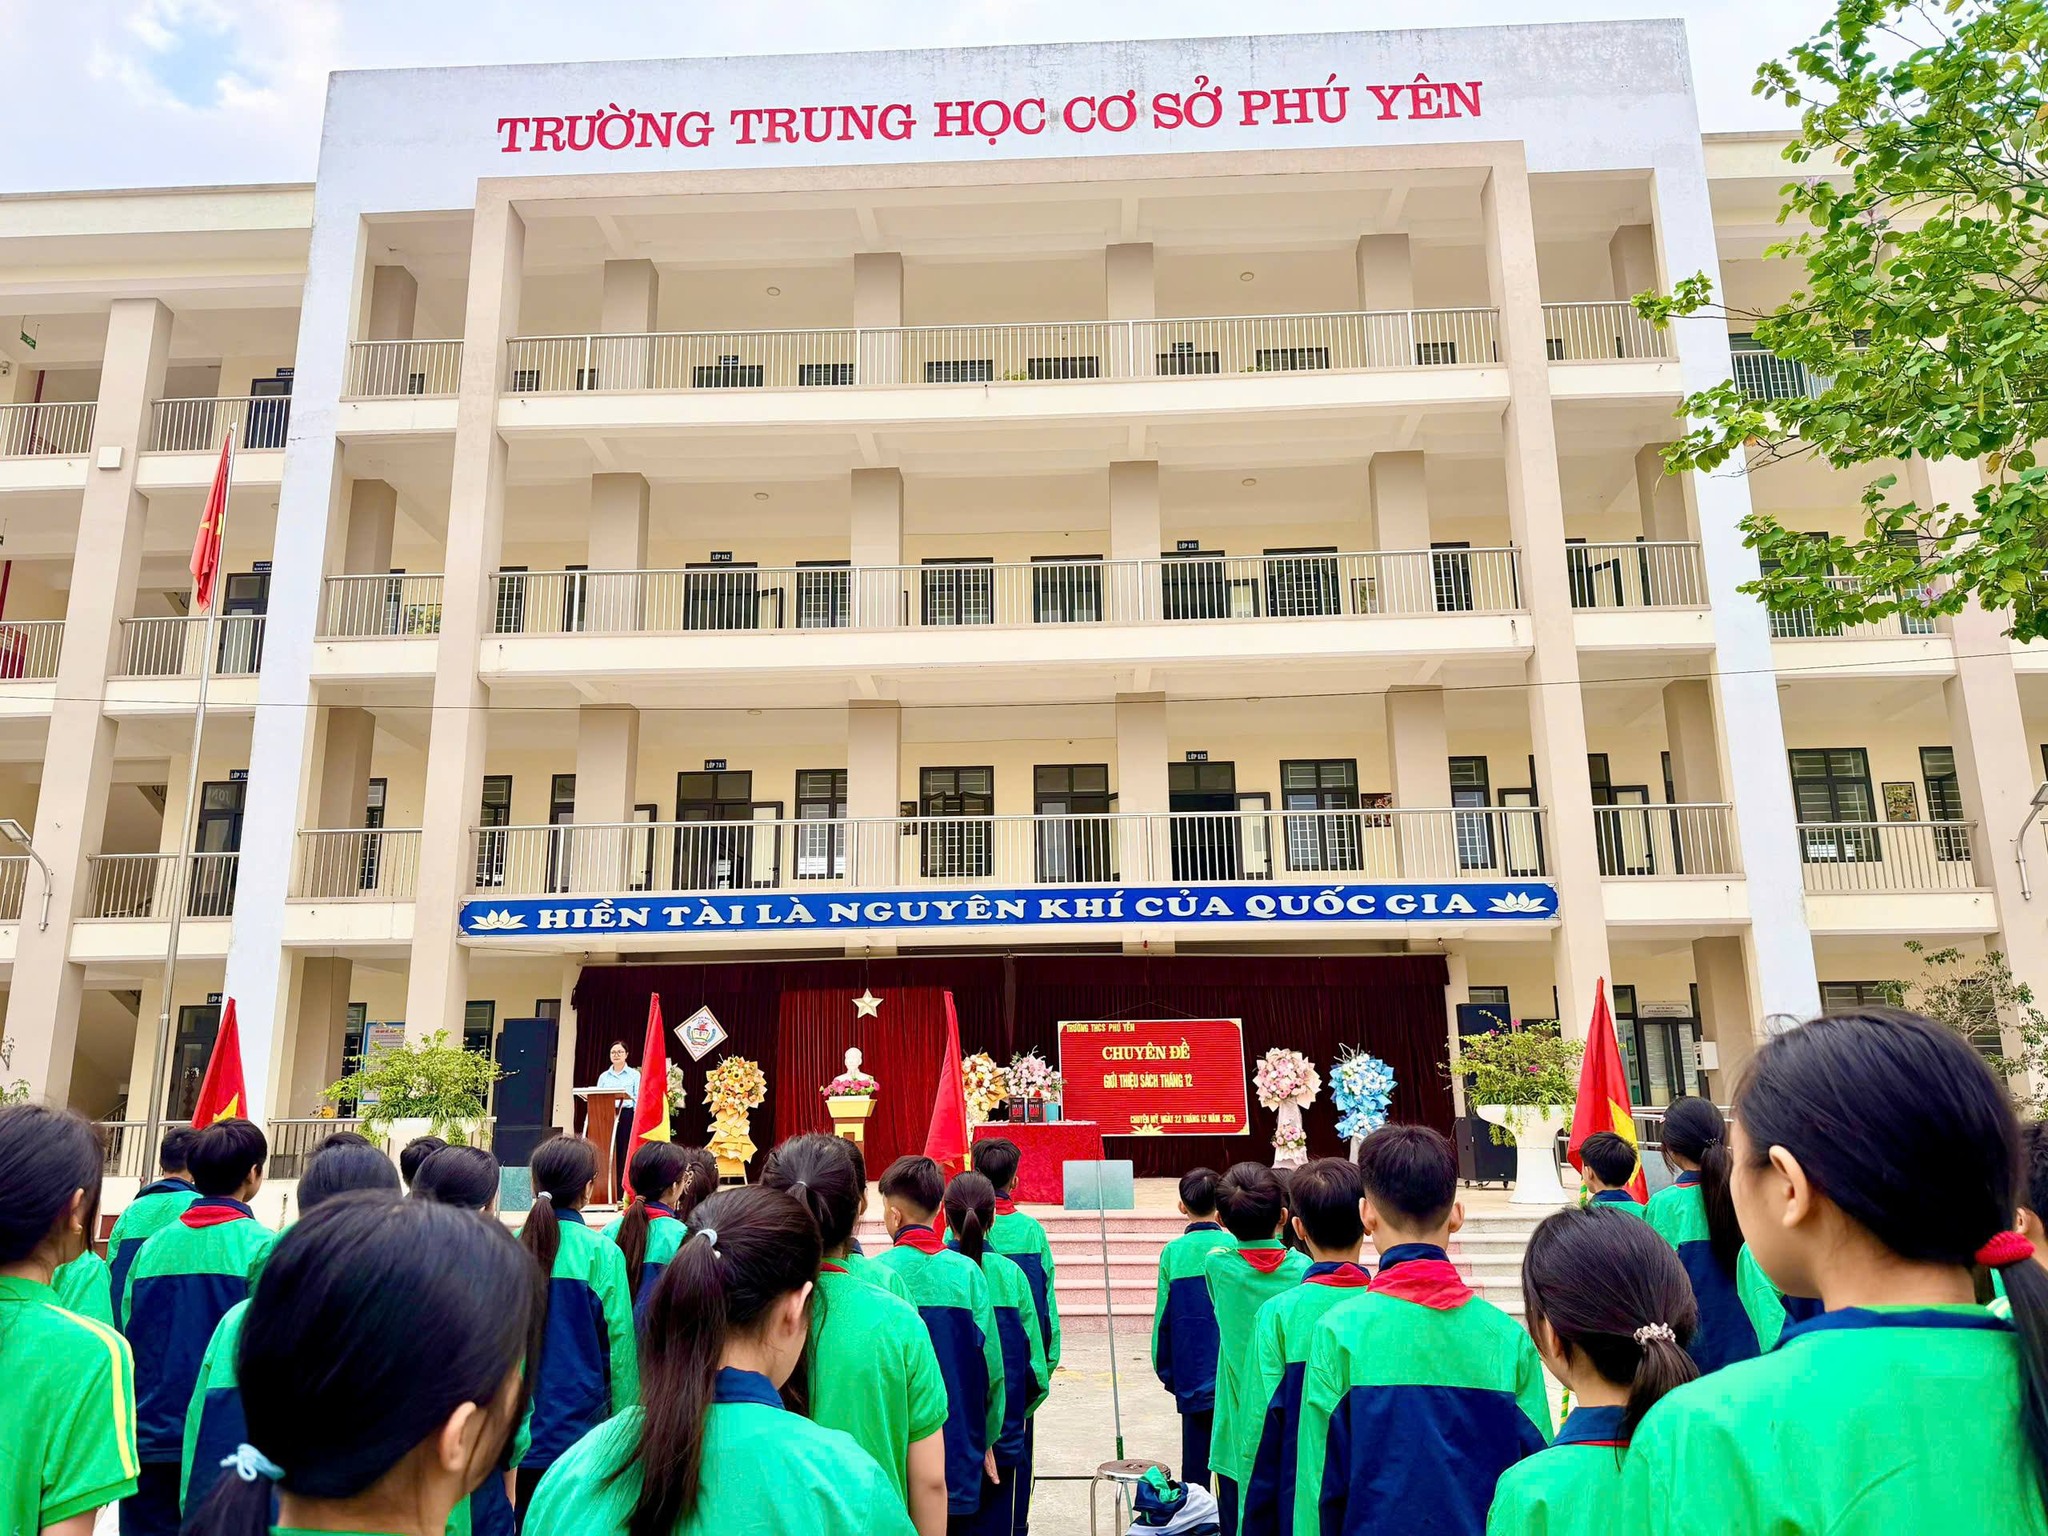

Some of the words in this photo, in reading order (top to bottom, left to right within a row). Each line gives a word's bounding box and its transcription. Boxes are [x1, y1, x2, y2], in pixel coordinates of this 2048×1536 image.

[498, 103, 715, 153] TRƯỜNG
[731, 105, 917, 144] TRUNG
[934, 98, 1046, 146] HỌC
[1063, 90, 1137, 134] CƠ
[1153, 75, 1223, 130] SỞ
[1238, 74, 1350, 127] PHÚ
[1367, 73, 1484, 121] YÊN
[536, 898, 651, 929] HIỀN
[661, 898, 745, 926] TÀI
[756, 896, 817, 924] LÀ
[829, 894, 1026, 922] NGUYÊN
[1038, 890, 1124, 919] KHÍ
[1136, 889, 1235, 918] CỦA
[1245, 886, 1377, 919] QUỐC
[1385, 894, 1477, 915] GIA
[1091, 1023, 1106, 1032] THCS
[1102, 1041, 1167, 1061] CHUYÊN
[1169, 1036, 1191, 1060] ĐỀ
[1119, 1071, 1139, 1090] THIỆU
[1140, 1071, 1159, 1088] SÁCH
[1160, 1071, 1184, 1088] THÁNG
[1184, 1073, 1194, 1087] 12
